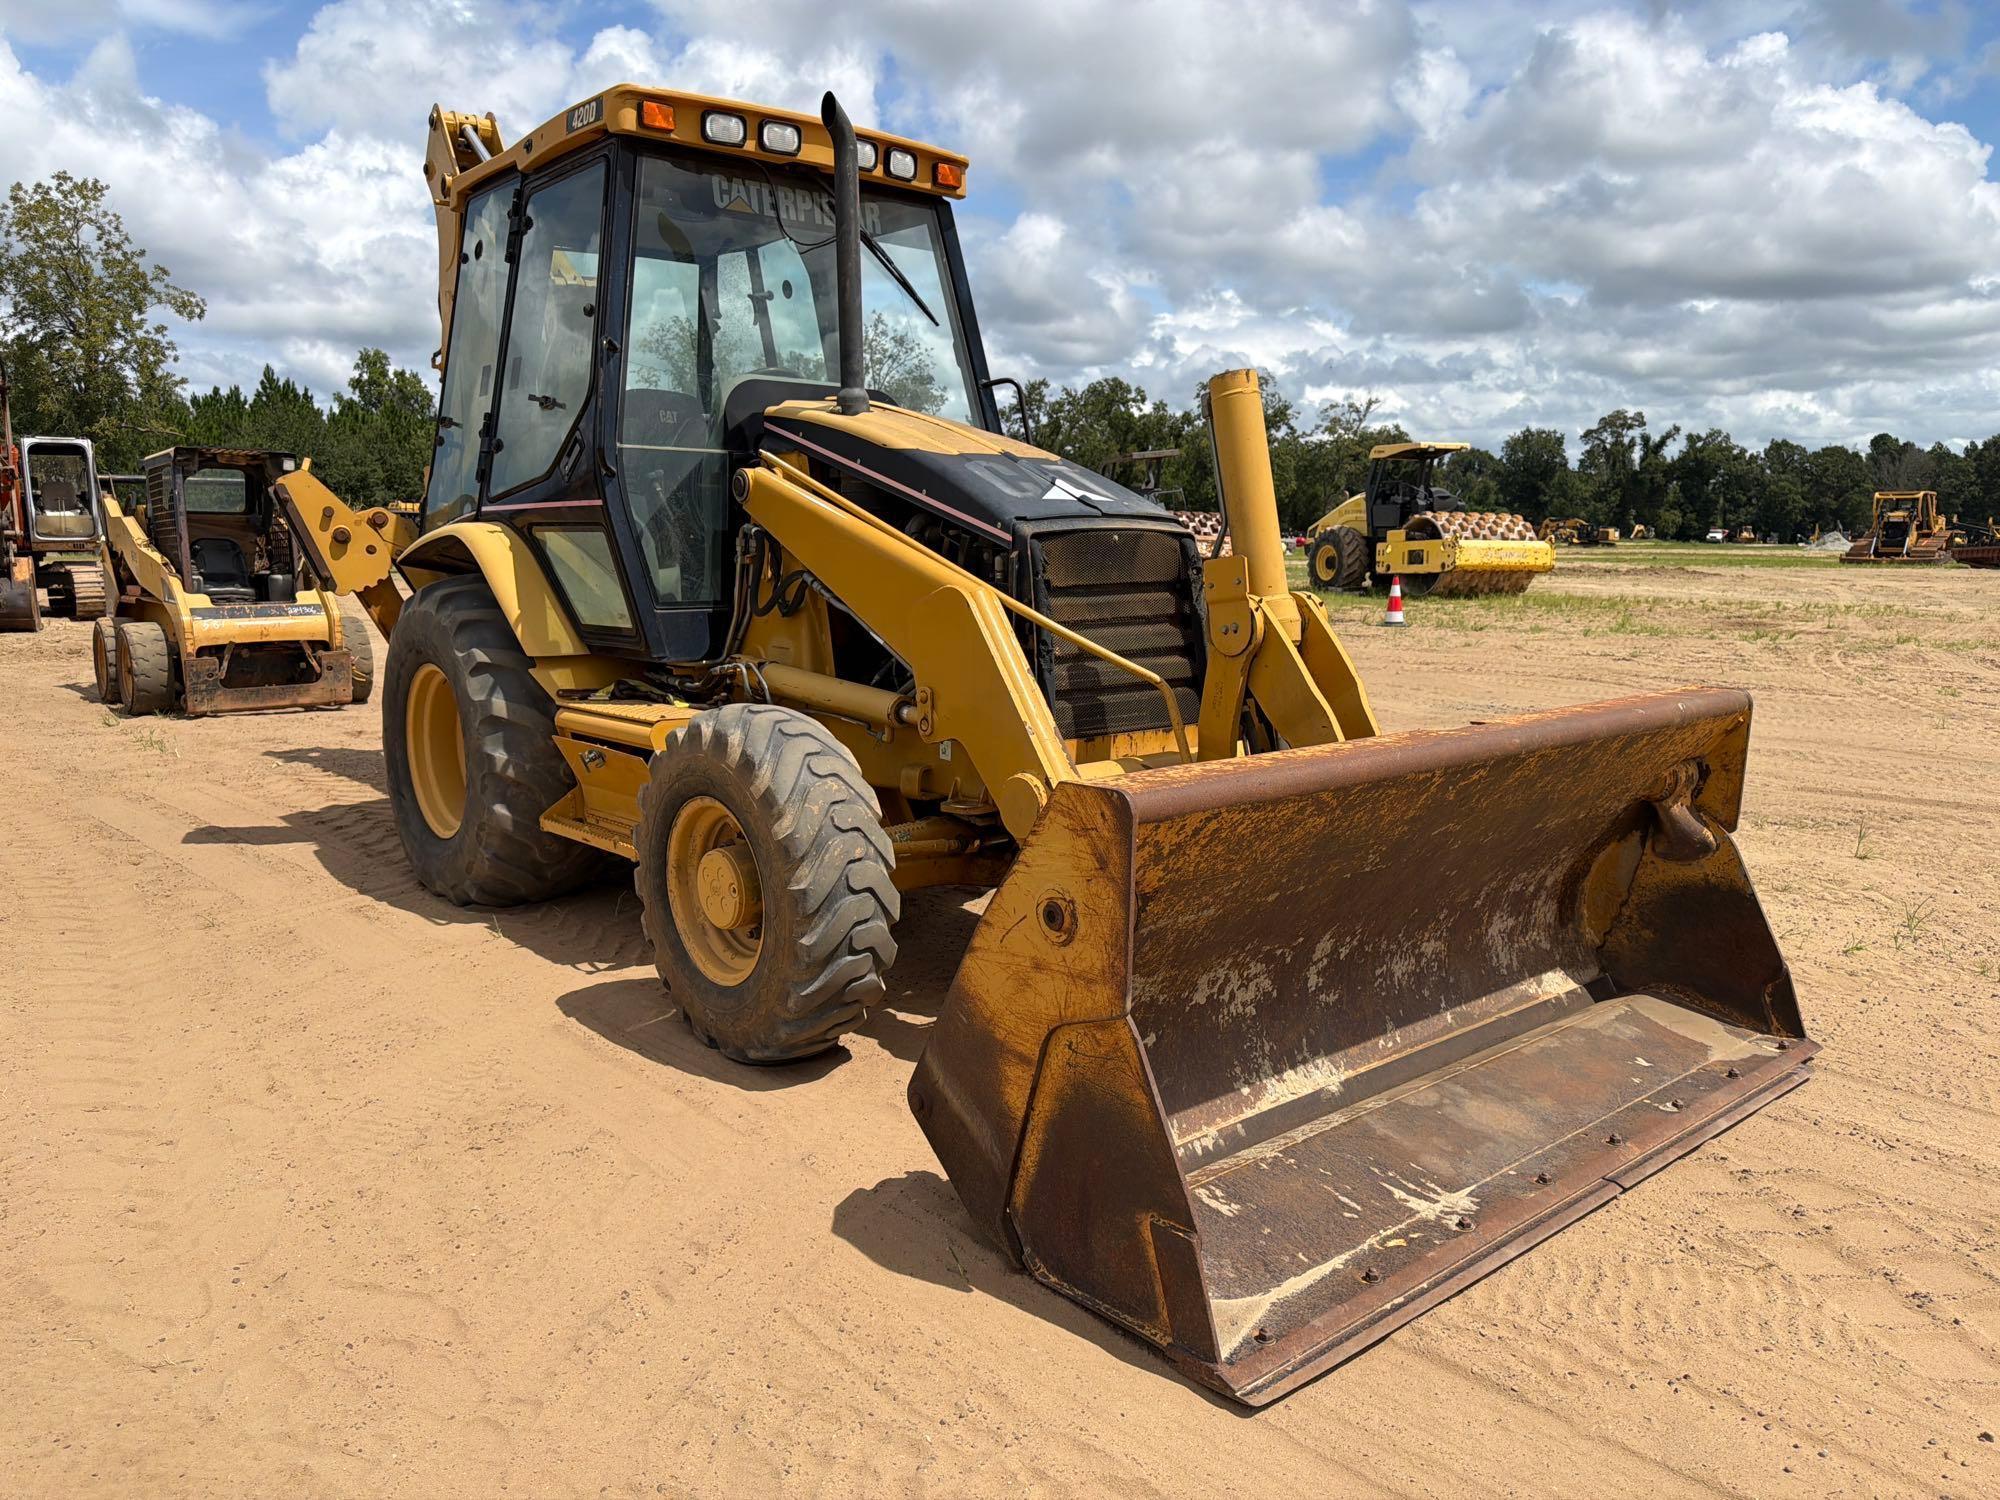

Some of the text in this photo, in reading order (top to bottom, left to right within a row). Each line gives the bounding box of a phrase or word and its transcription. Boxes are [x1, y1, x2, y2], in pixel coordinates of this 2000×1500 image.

[572, 101, 597, 129] 420D
[712, 174, 882, 234] CATERPILR
[659, 409, 679, 424] CAT
